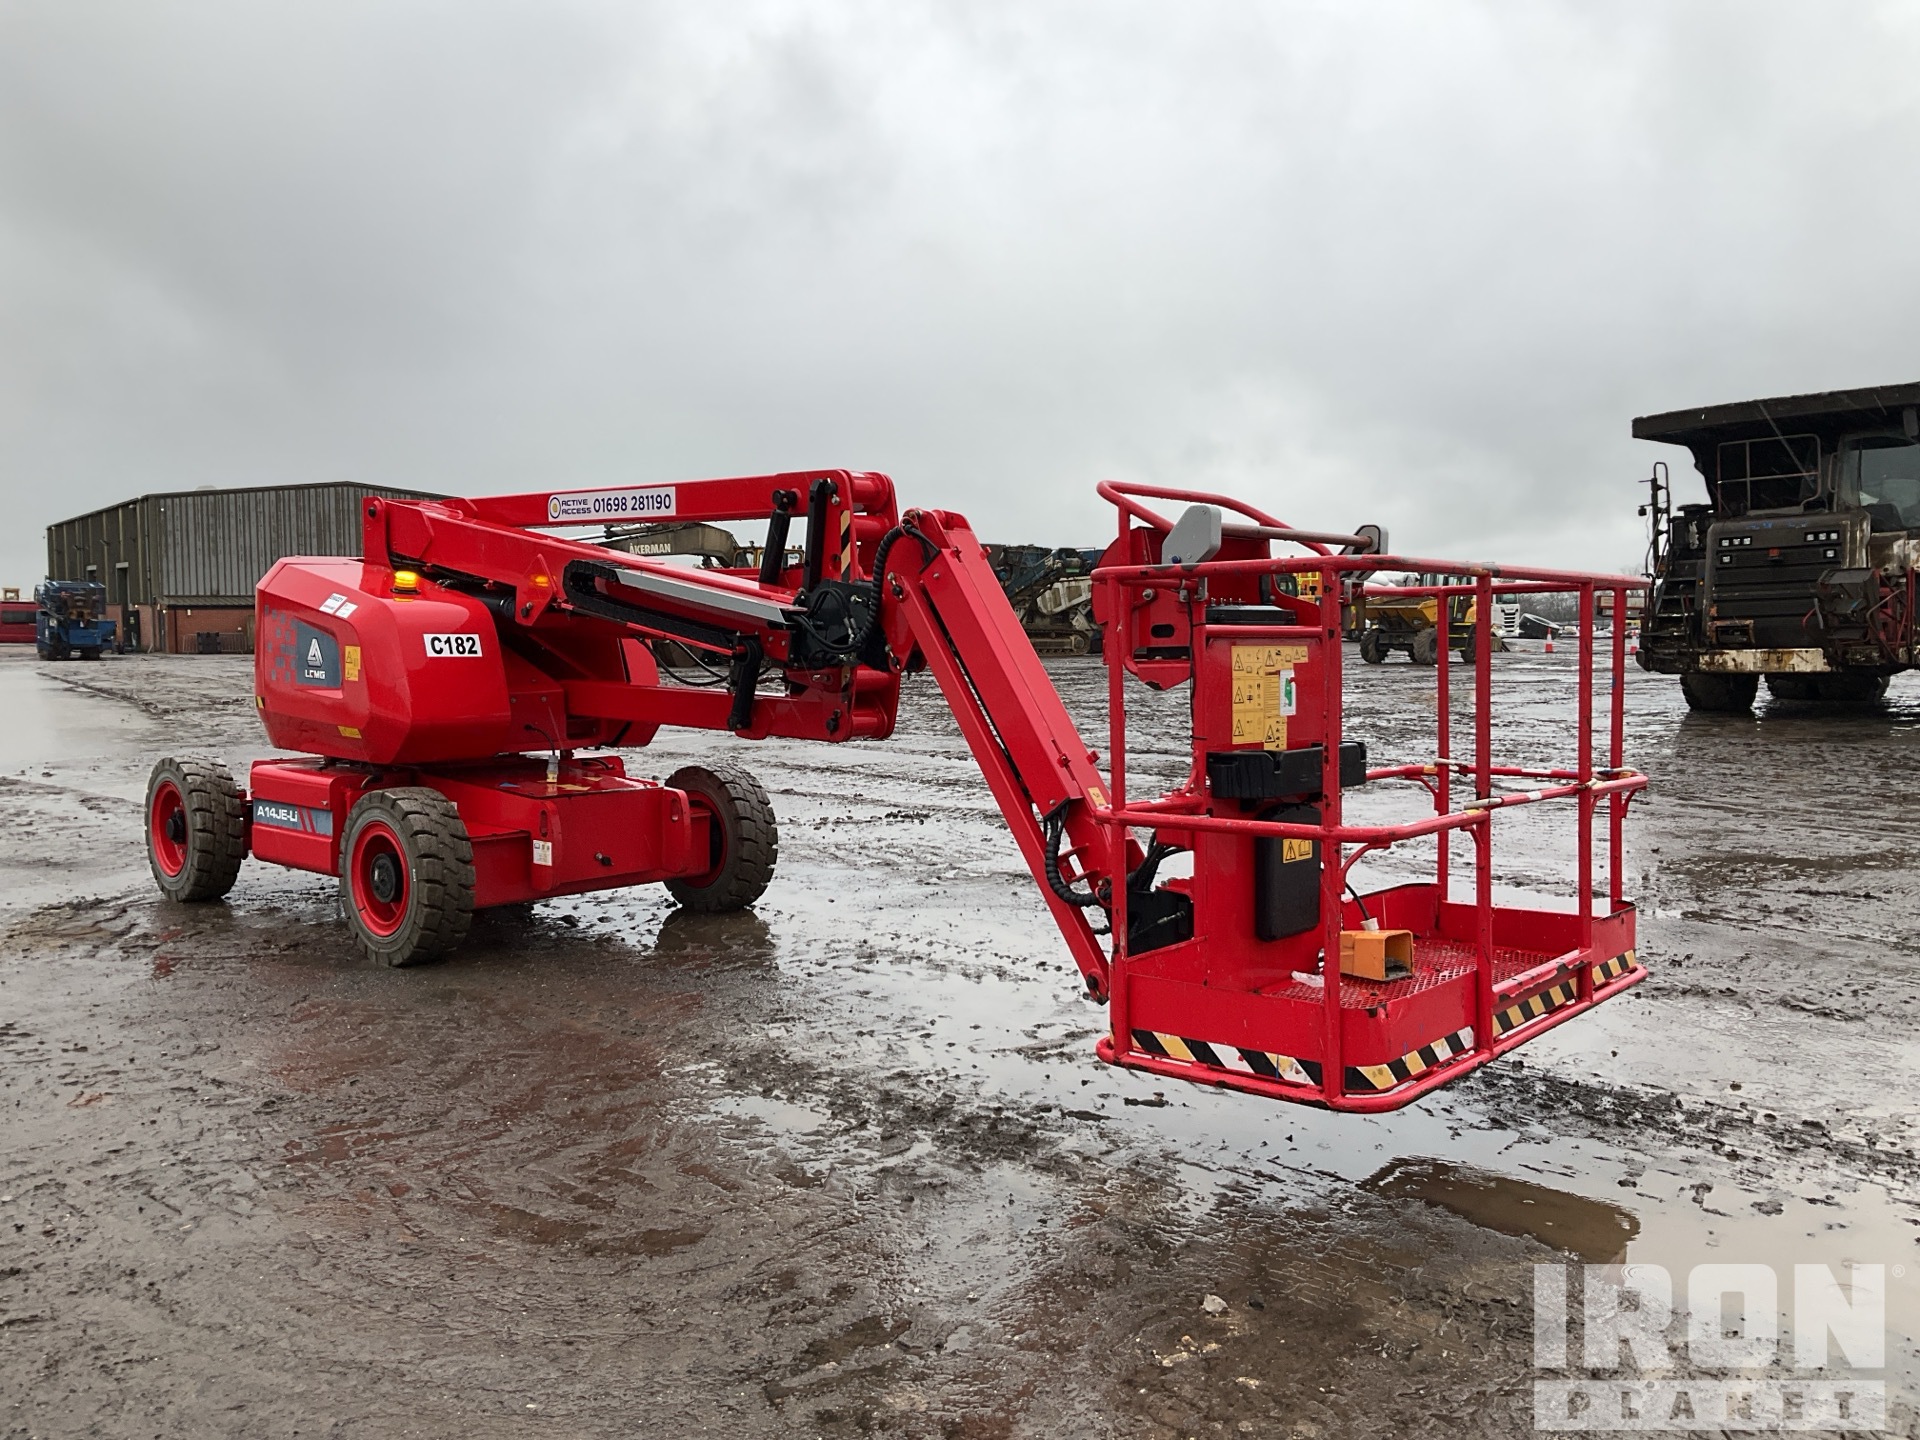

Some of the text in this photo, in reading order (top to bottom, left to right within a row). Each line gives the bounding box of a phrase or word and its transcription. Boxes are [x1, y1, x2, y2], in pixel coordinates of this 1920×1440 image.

[562, 499, 588, 507] ACTIVE
[593, 493, 672, 513] 01698 281190
[562, 507, 592, 515] ACCESS
[629, 543, 671, 555] ÅKERMAN
[430, 636, 478, 655] C182
[257, 805, 298, 822] A14JE-Li
